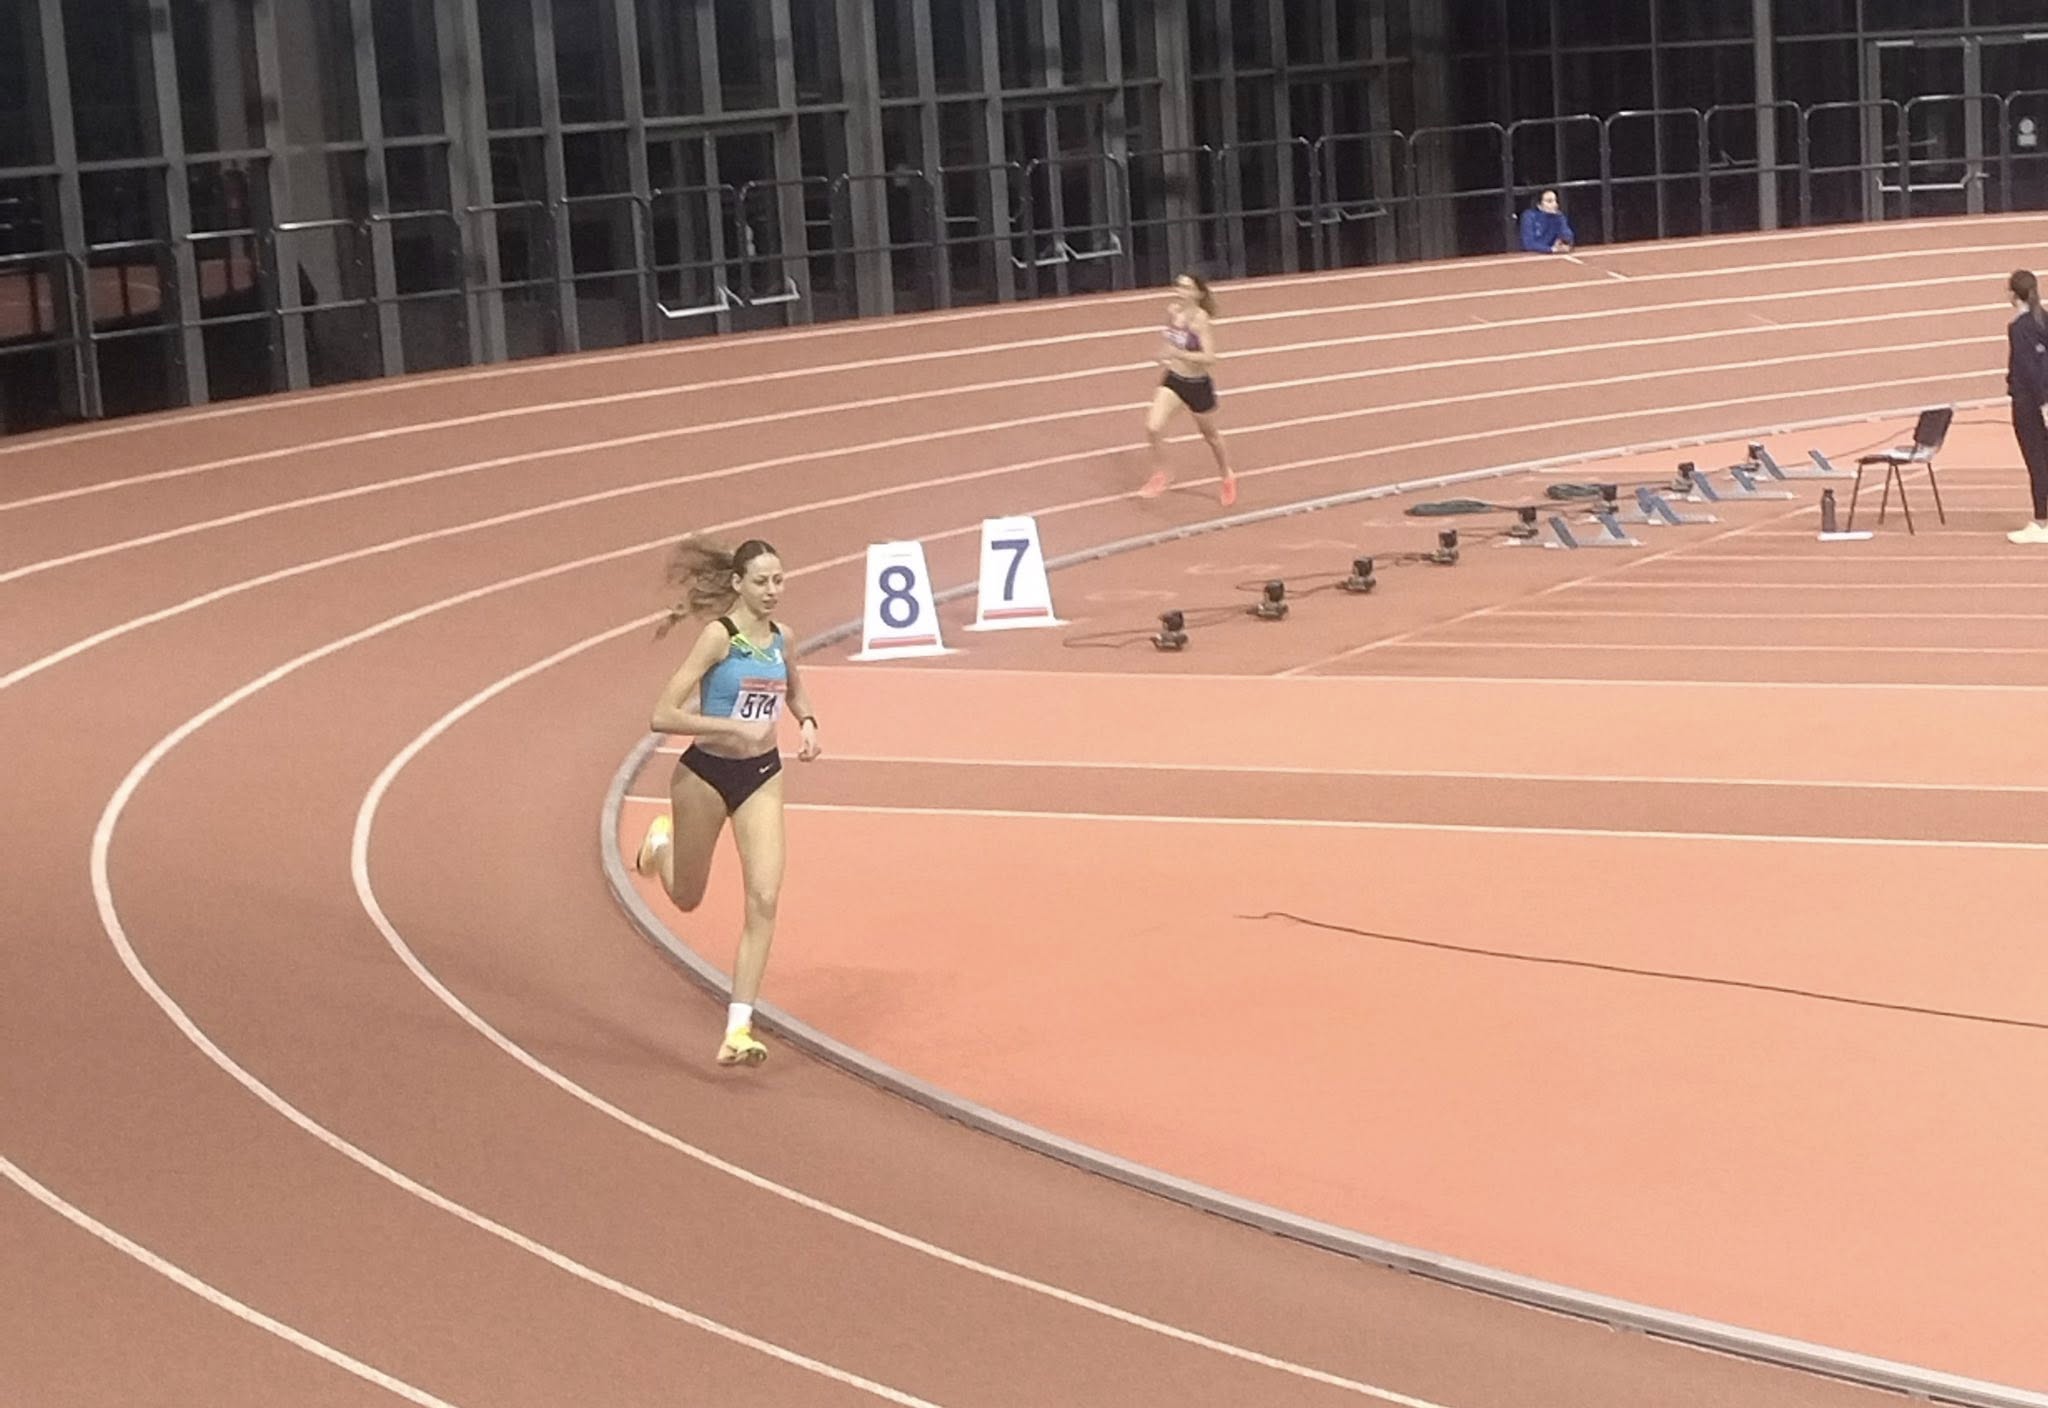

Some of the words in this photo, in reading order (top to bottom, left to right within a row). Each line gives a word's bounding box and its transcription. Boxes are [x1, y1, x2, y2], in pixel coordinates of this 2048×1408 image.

[878, 565, 920, 629] 8
[991, 539, 1030, 601] 7
[740, 693, 778, 719] 574
